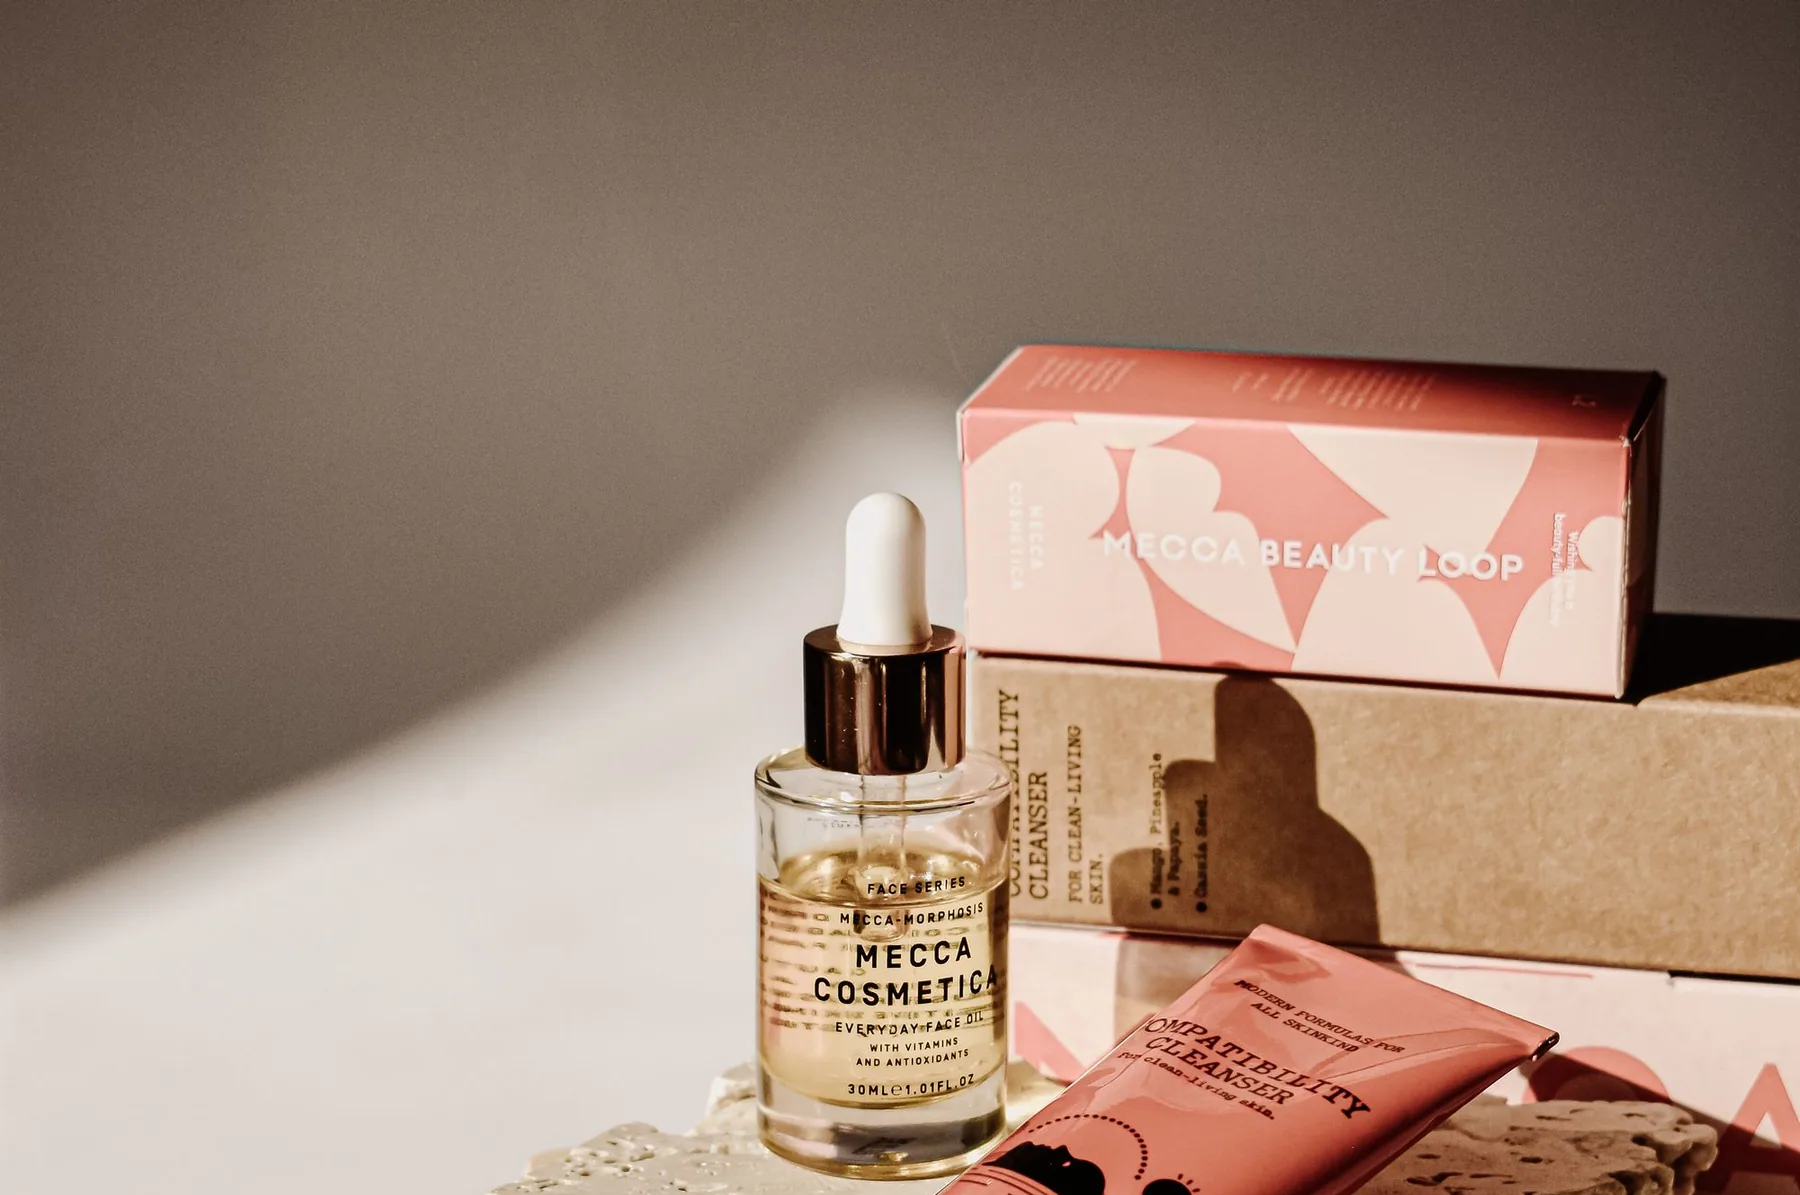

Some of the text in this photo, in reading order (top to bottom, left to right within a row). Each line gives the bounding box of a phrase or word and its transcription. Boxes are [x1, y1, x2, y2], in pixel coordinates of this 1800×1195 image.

[1103, 530, 1525, 581] MECCA BEAUTY LOOP
[1067, 725, 1083, 903] FOR CLEAN-LIVING
[1149, 752, 1165, 835] Pineapple
[1027, 771, 1049, 900] CLEANSER
[867, 876, 966, 895] FACE SERIES
[1089, 853, 1104, 905] SKIN.
[840, 902, 984, 926] MECCA-MORPHOSIS
[856, 936, 972, 969] MECCA
[814, 964, 998, 1006] COSMETICA
[835, 1011, 985, 1036] EVERYDAY FACE OIL
[1234, 979, 1406, 1053] MODERN FORMULAS FOR
[1250, 1002, 1360, 1052] ALL SKINKIND
[856, 1048, 970, 1067] AND ANTIOXIDANTS
[869, 1036, 959, 1053] WITH VITAMINS
[1144, 1017, 1371, 1120] OMPATIBILITY
[1117, 1051, 1275, 1120] for clean-living skin.
[1145, 1036, 1295, 1106] CLEANSER
